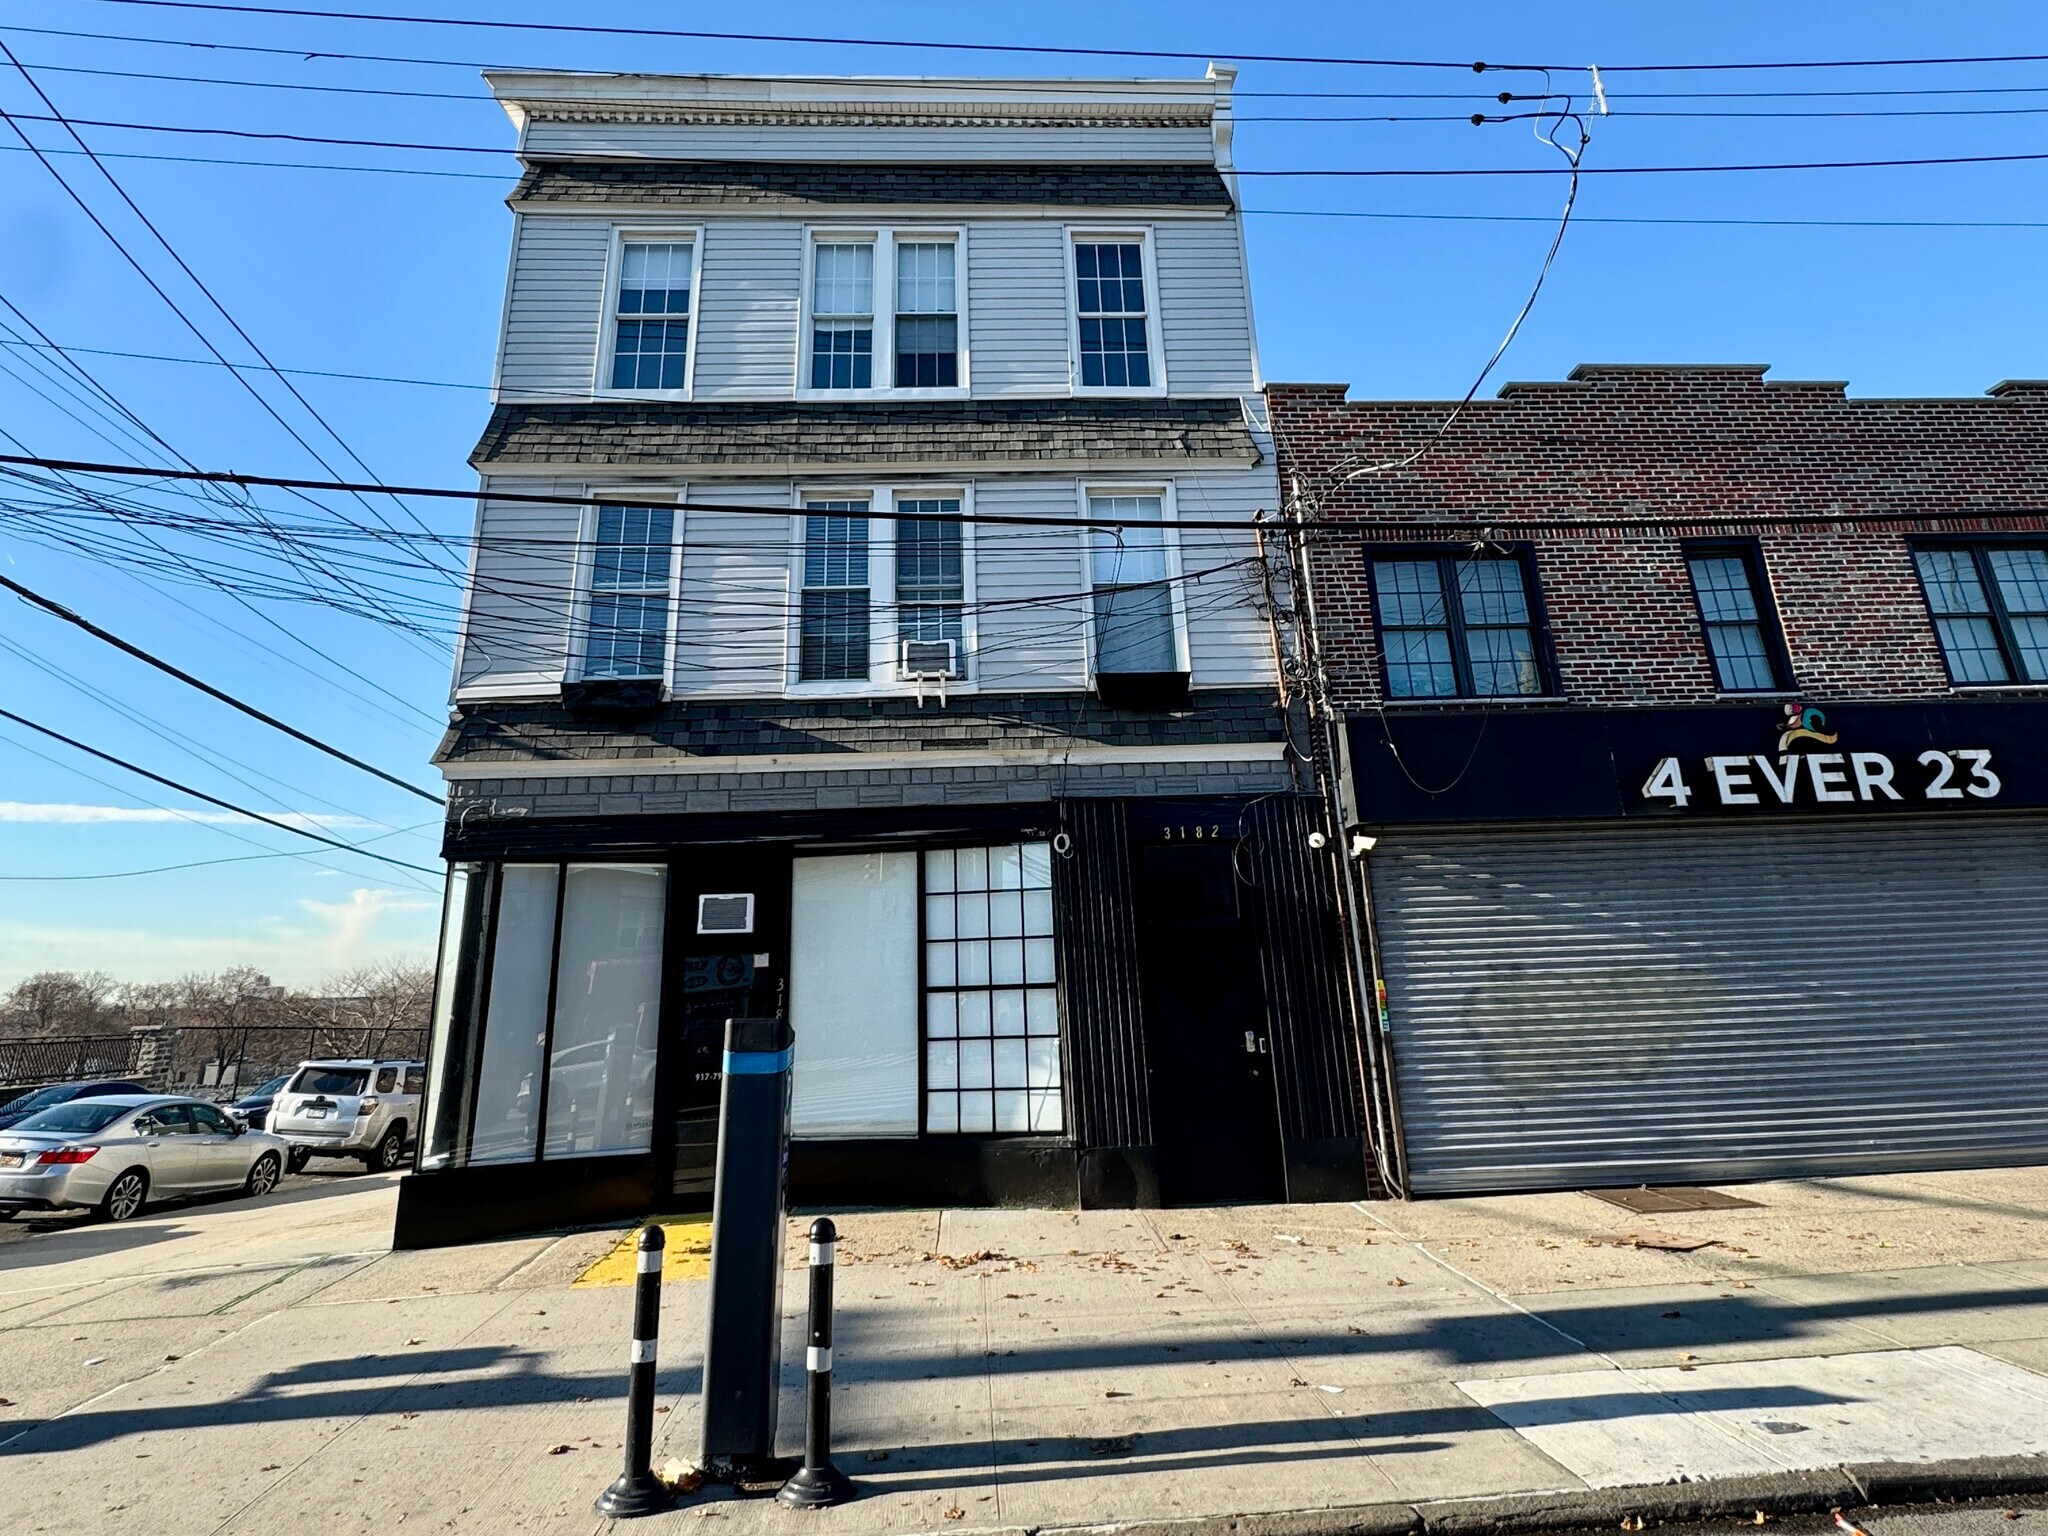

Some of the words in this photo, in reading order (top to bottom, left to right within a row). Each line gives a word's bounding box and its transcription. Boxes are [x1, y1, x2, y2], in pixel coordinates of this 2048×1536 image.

[1642, 756, 1692, 807] 4
[1704, 752, 1905, 805] EVER
[1917, 749, 2001, 799] 23
[1163, 824, 1219, 840] 3182
